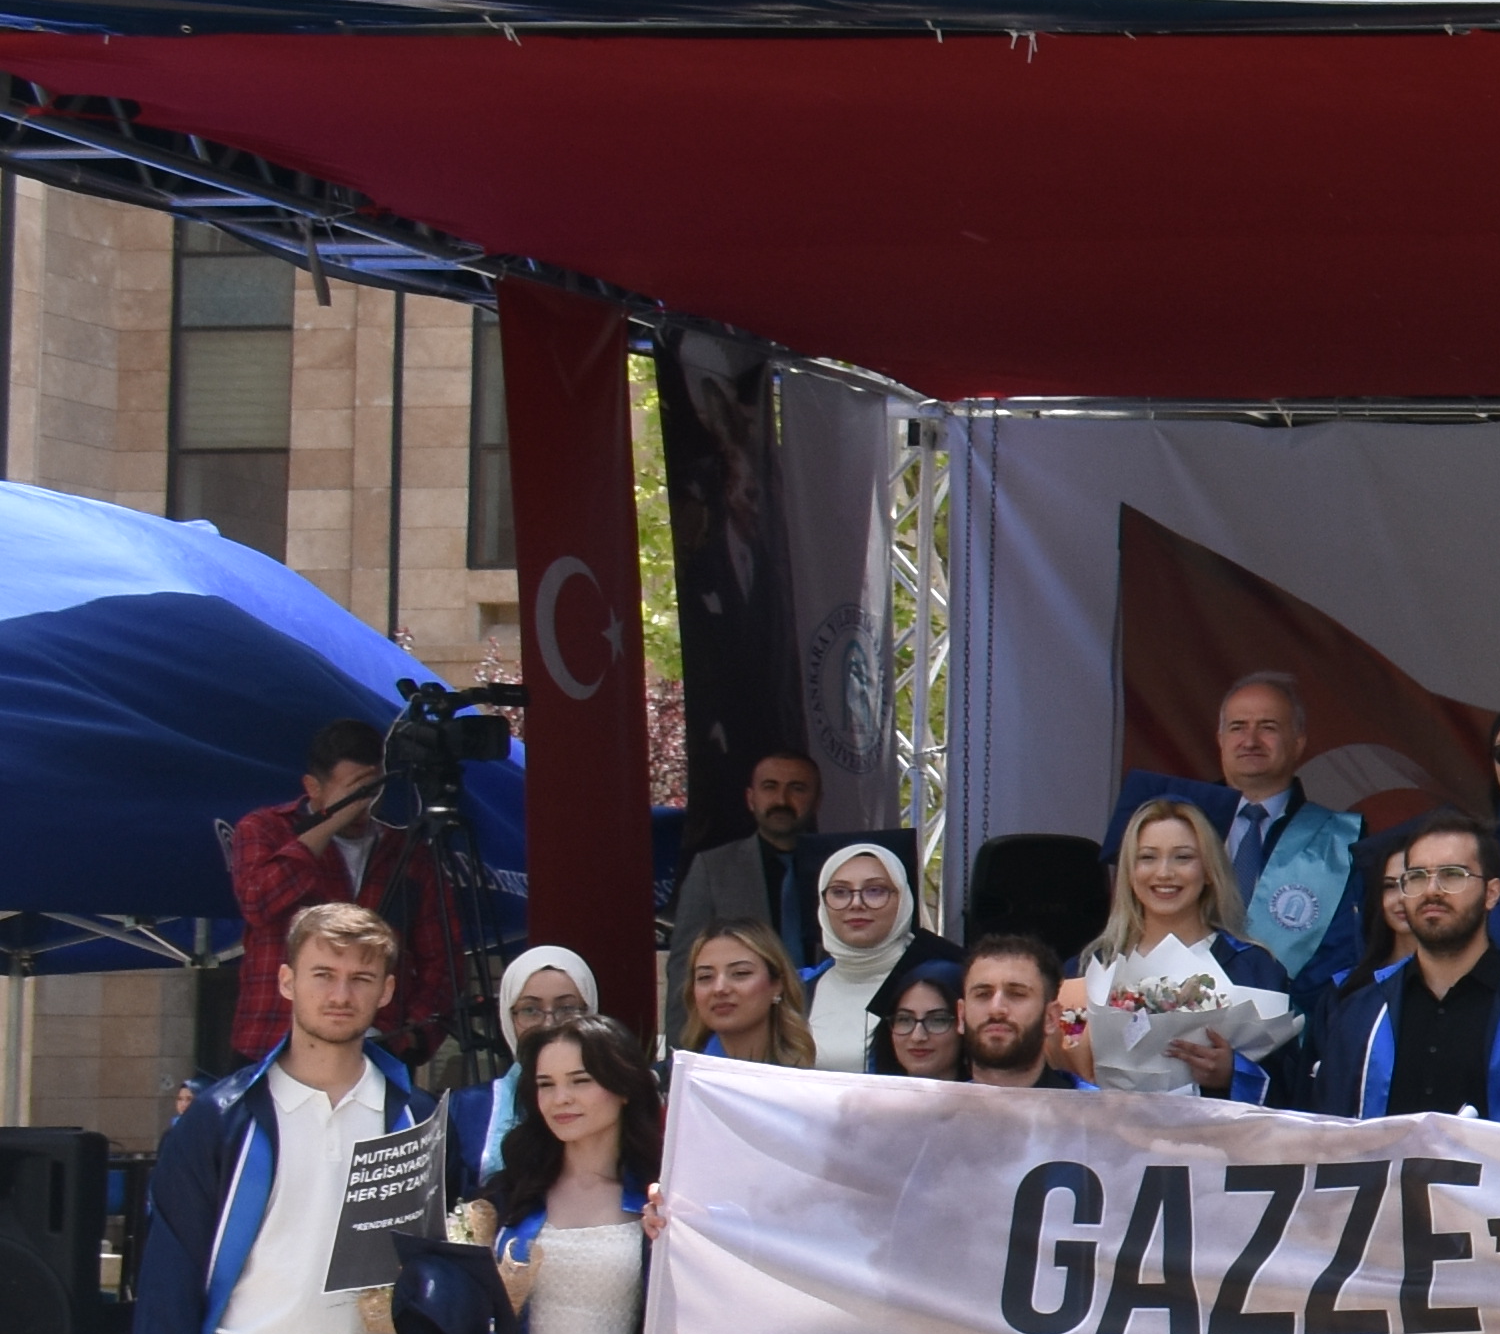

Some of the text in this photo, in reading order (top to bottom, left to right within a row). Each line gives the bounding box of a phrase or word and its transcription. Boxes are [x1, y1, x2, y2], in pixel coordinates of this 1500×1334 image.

[353, 1140, 419, 1167] MUTFAKTA
[346, 1187, 378, 1203] HER
[379, 1181, 406, 1201] ŞEY
